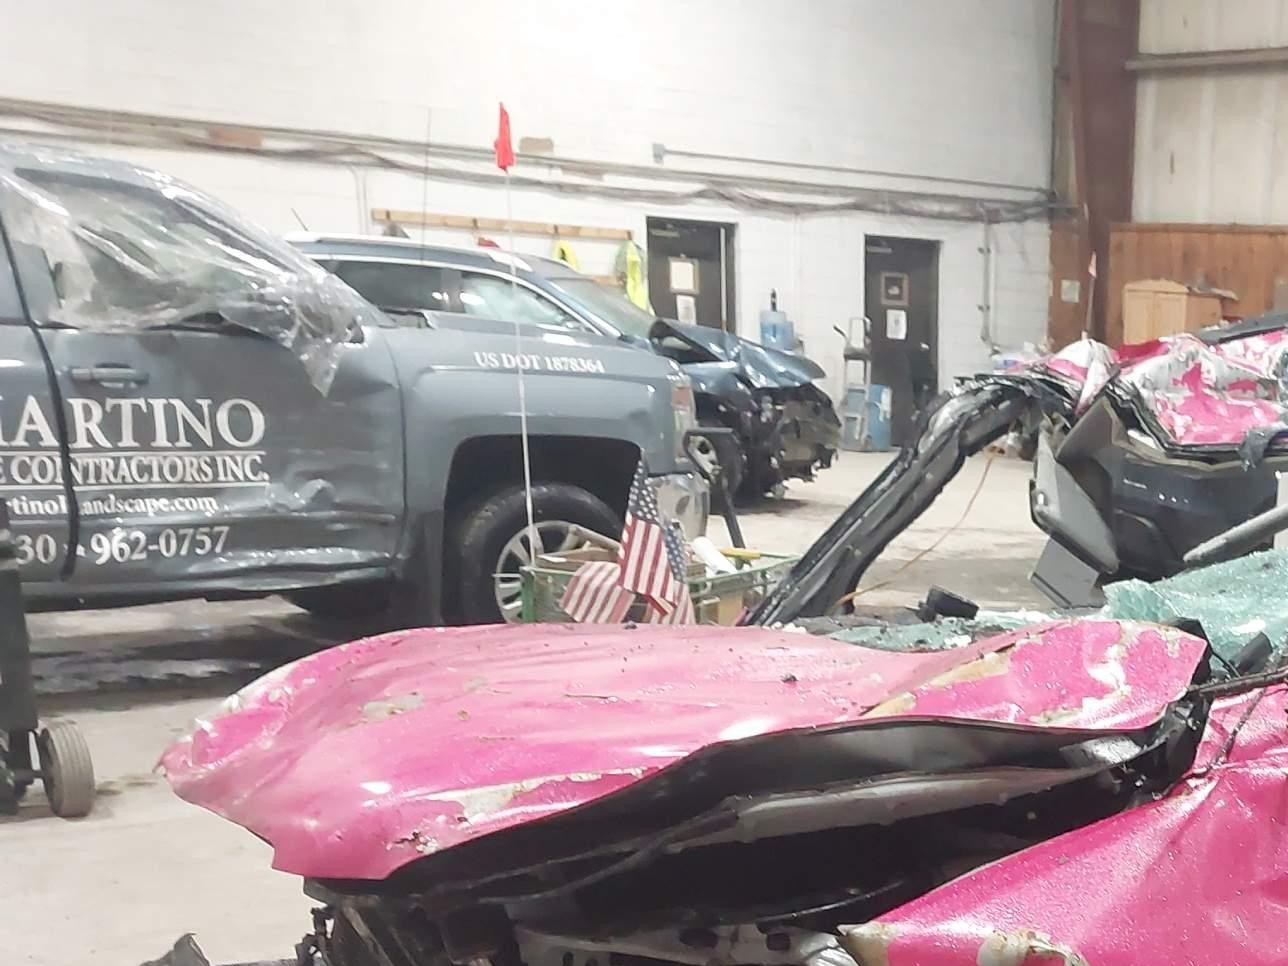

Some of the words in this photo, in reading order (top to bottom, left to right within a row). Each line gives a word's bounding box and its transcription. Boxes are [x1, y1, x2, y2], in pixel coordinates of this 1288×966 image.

[474, 351, 500, 368] US
[501, 353, 541, 370] DOT
[10, 455, 213, 485] CONTRACTORS
[216, 454, 270, 482] INC.
[6, 494, 219, 517] tinolandscape.com
[90, 526, 230, 566] 962-0757
